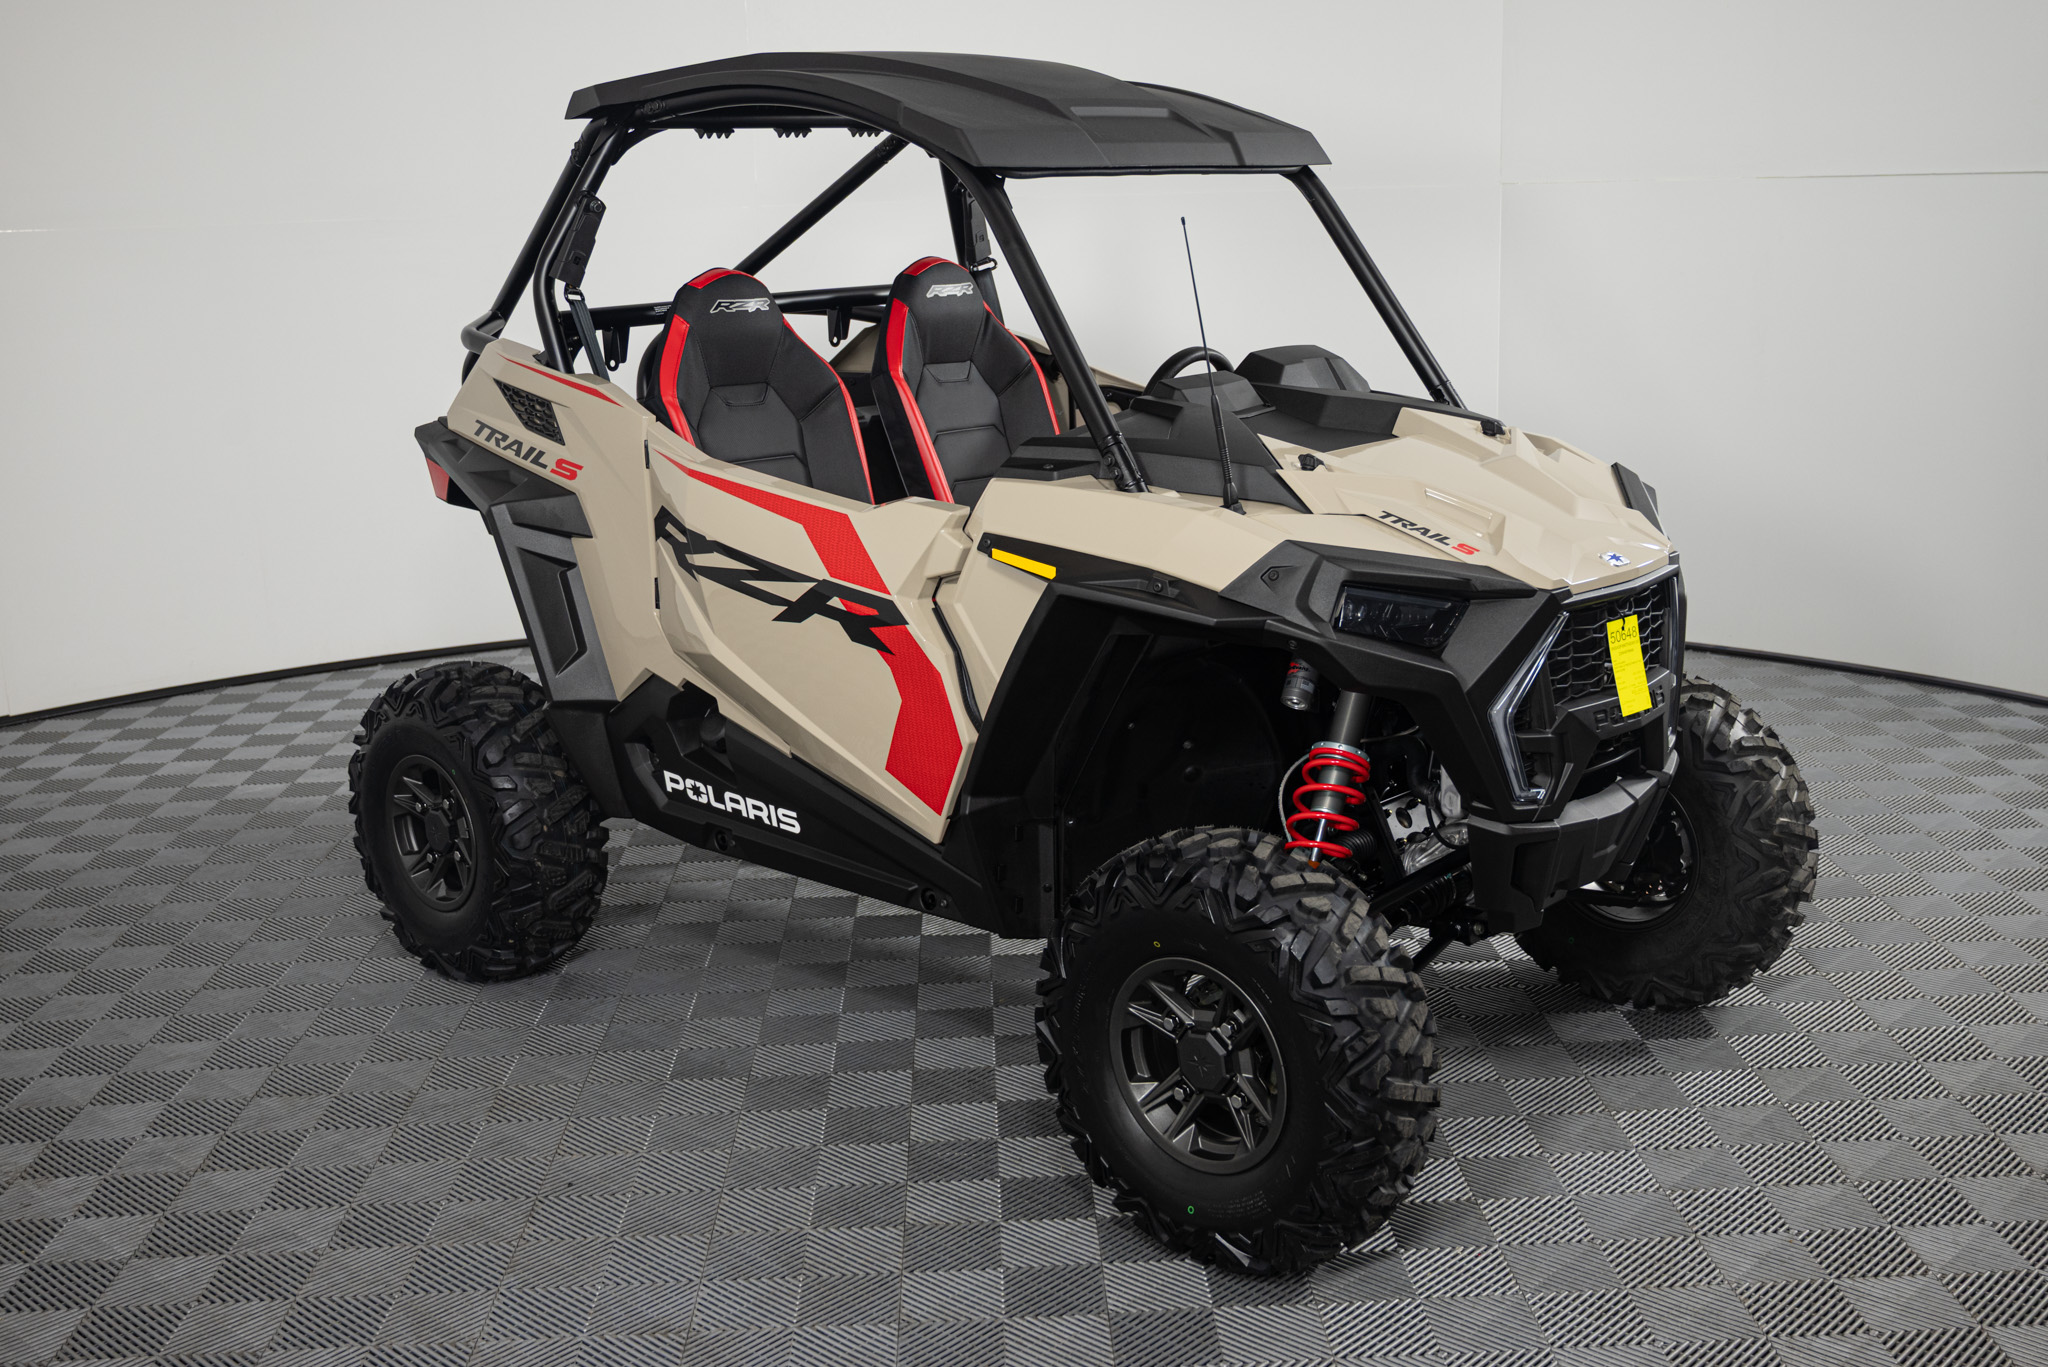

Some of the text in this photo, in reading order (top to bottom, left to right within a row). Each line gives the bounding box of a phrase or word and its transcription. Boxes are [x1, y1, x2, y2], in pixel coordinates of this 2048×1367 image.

[710, 298, 770, 313] RZR
[926, 282, 973, 298] RZR
[474, 419, 584, 481] TRAIL S
[1378, 510, 1481, 556] TRAIL S
[654, 505, 909, 656] RZR
[1610, 626, 1638, 645] 50648
[663, 770, 801, 834] POLARIS
